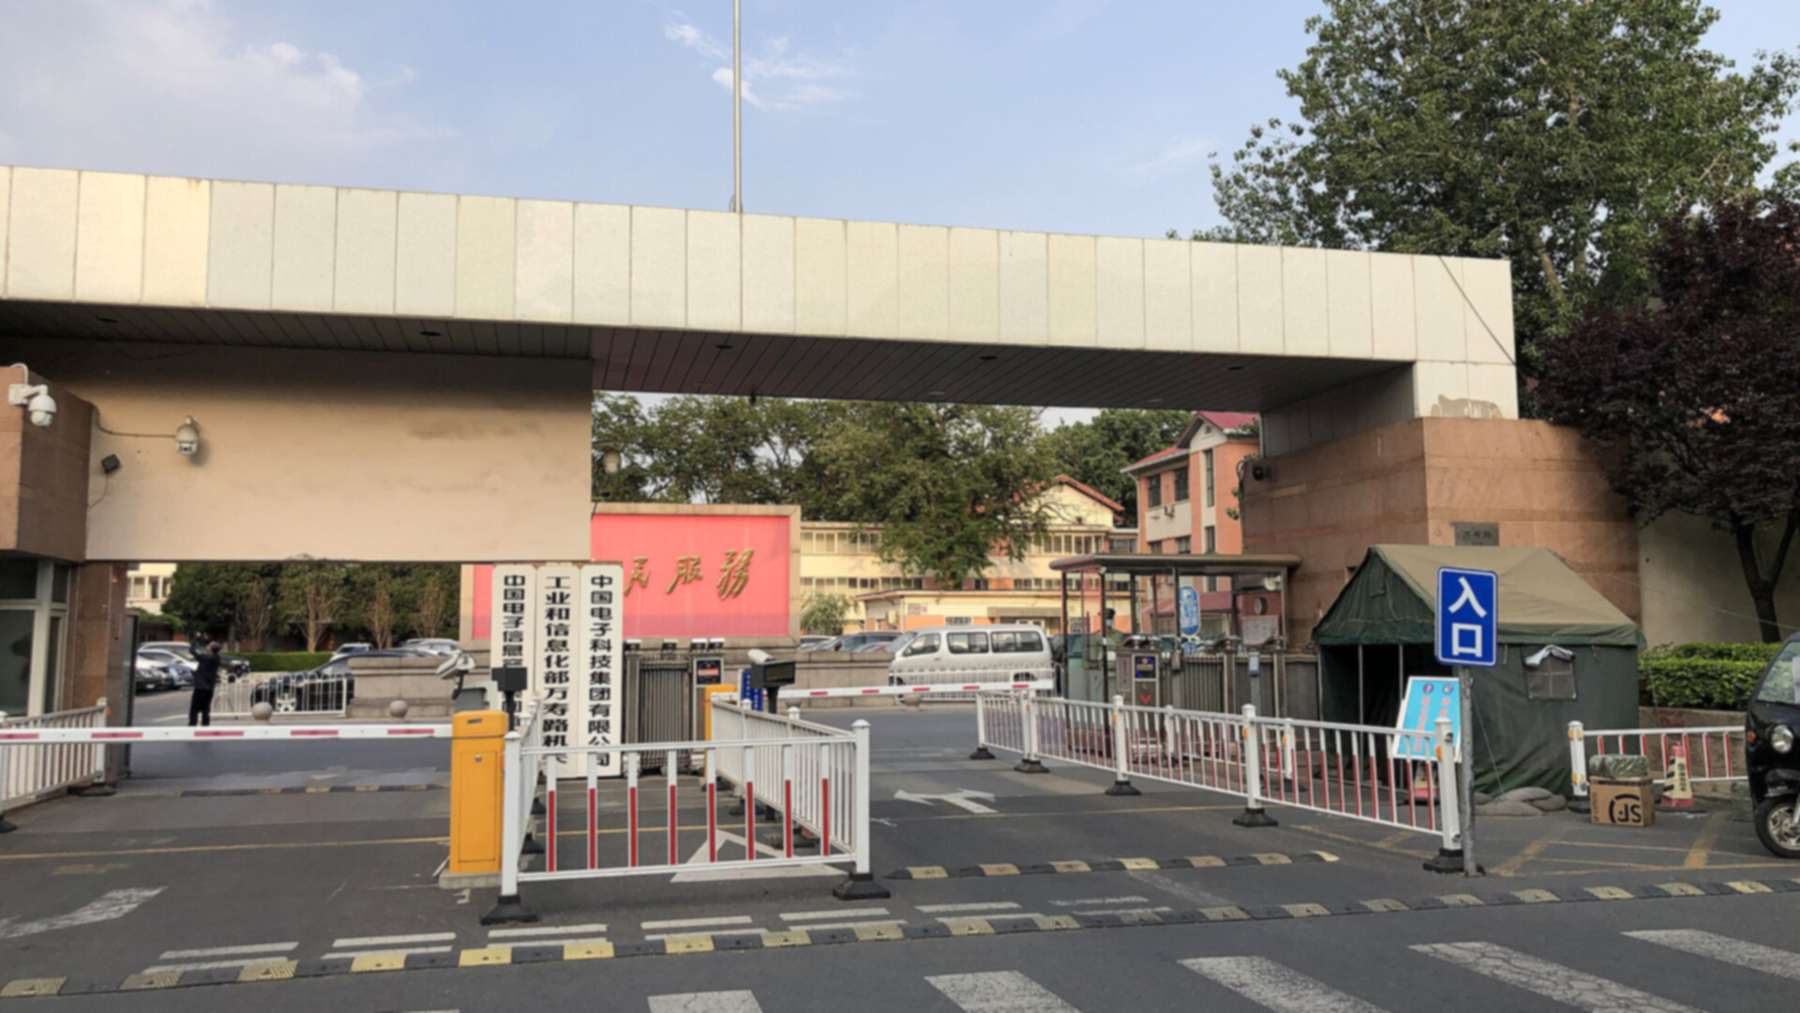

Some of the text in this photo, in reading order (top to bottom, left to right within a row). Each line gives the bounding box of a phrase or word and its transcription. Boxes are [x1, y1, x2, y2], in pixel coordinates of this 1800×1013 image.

[588, 575, 613, 766] 中国电子科技集团有限公司
[1448, 576, 1488, 658] 入口
